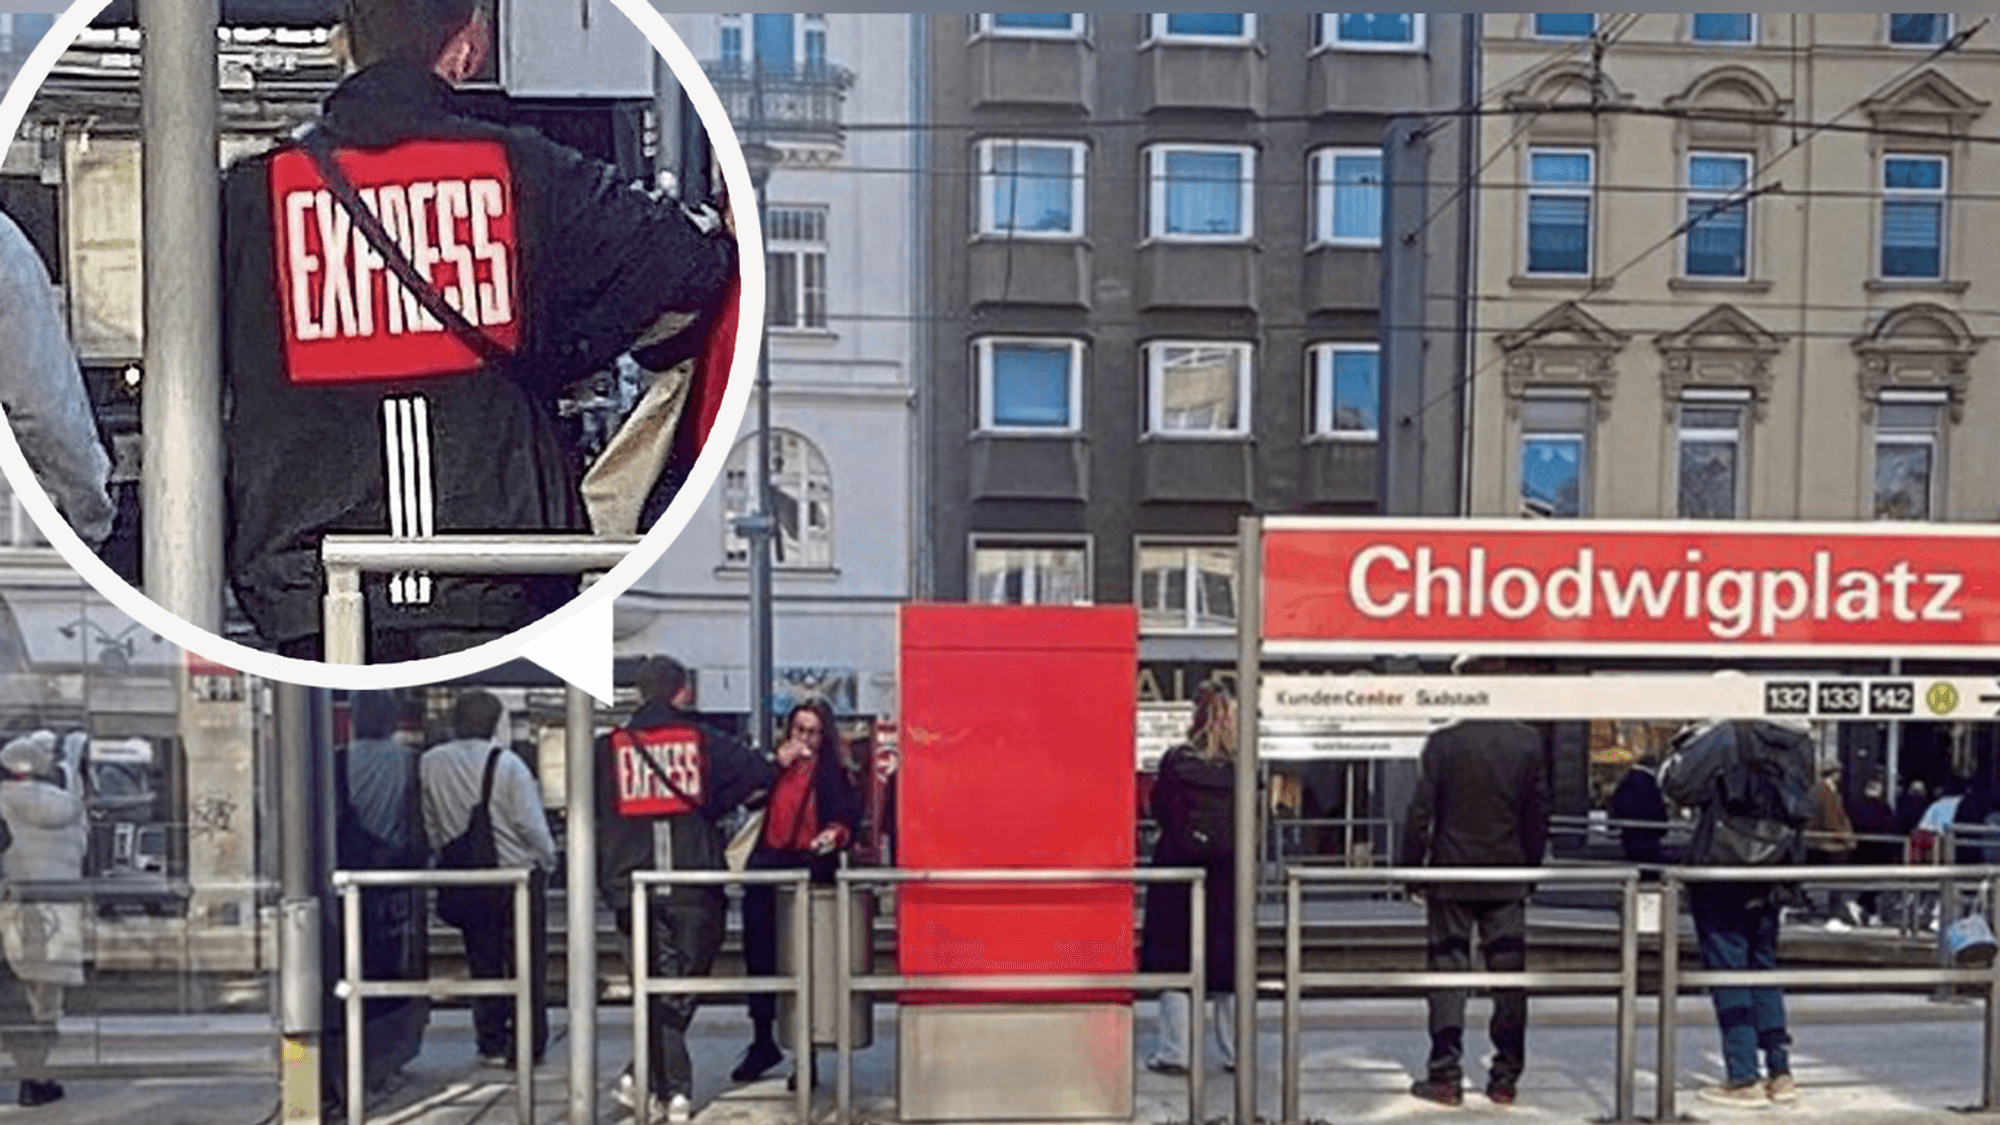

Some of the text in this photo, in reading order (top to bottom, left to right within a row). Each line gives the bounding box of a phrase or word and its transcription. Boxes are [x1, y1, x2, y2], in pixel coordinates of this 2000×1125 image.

[286, 178, 512, 341] EXPRESS
[1349, 545, 1962, 637] Chlodwigplatz
[1275, 689, 1405, 706] KundenCenter
[1769, 687, 1808, 709] 132
[1821, 687, 1860, 709] 133
[1872, 687, 1911, 709] 142
[617, 742, 700, 800] EXPRESS
